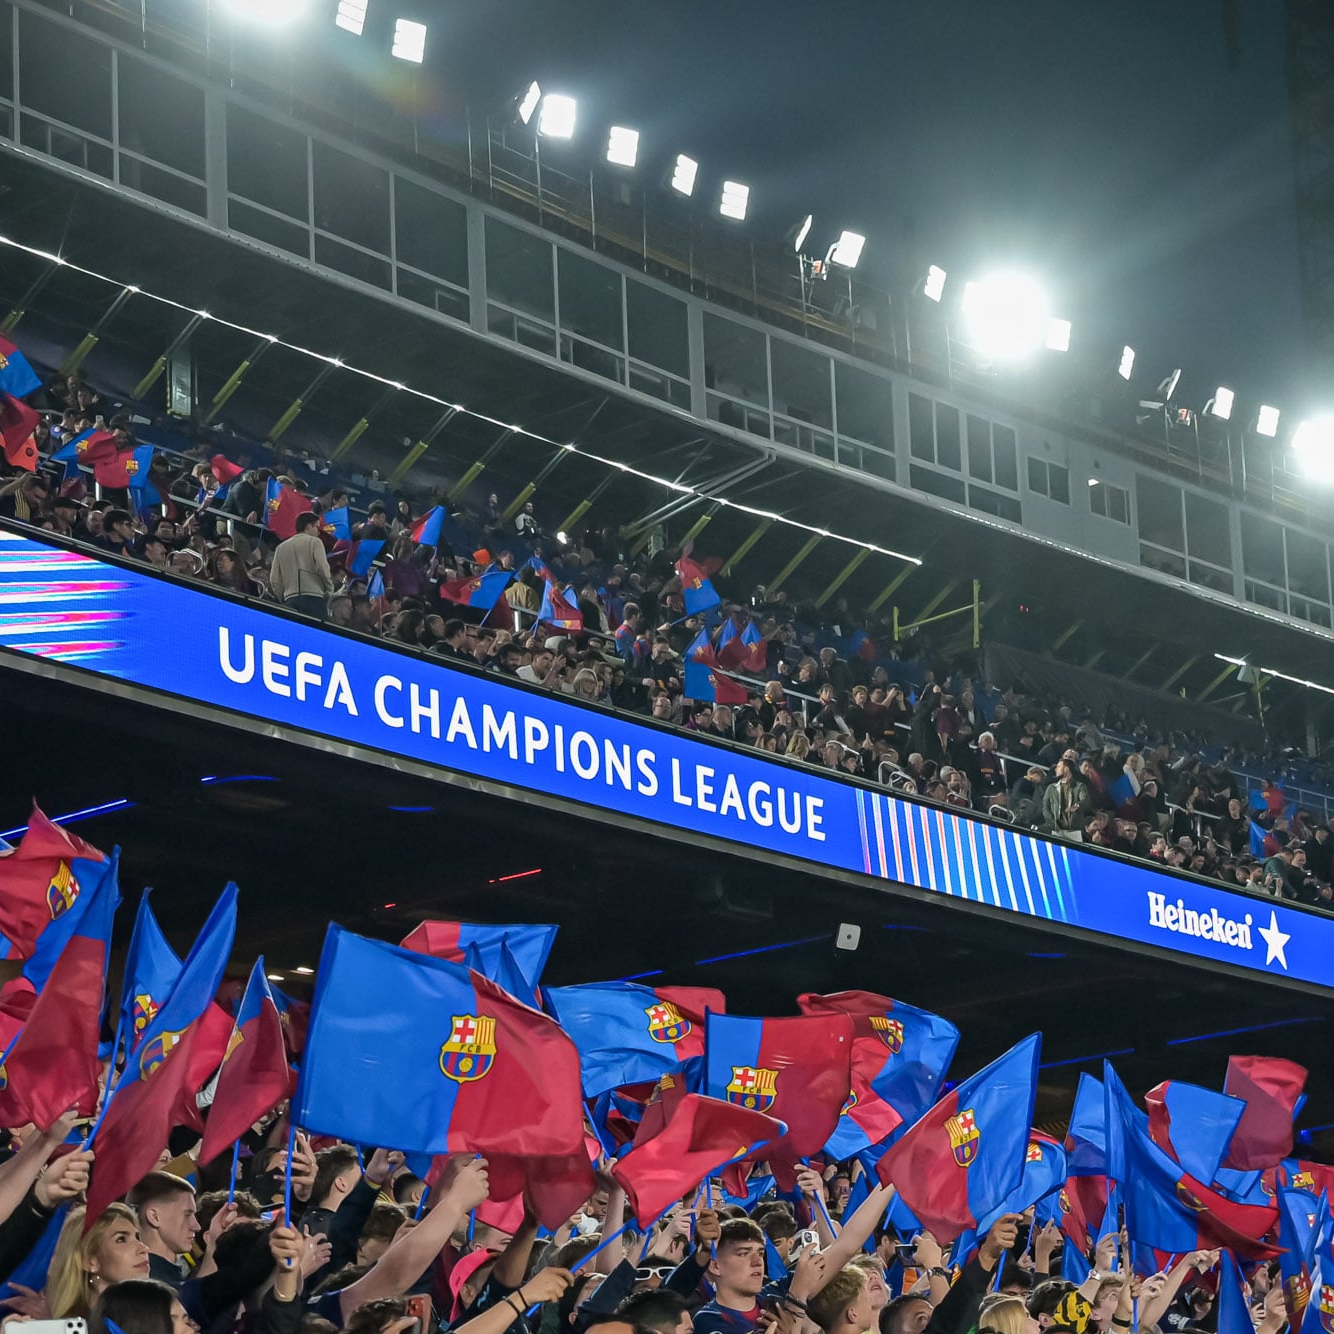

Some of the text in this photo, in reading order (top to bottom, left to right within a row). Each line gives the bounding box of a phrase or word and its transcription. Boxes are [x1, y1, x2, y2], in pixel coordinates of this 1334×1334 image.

[218, 626, 827, 842] UEFA CHAMPIONS LEAGUE
[1147, 891, 1253, 950] Heineken
